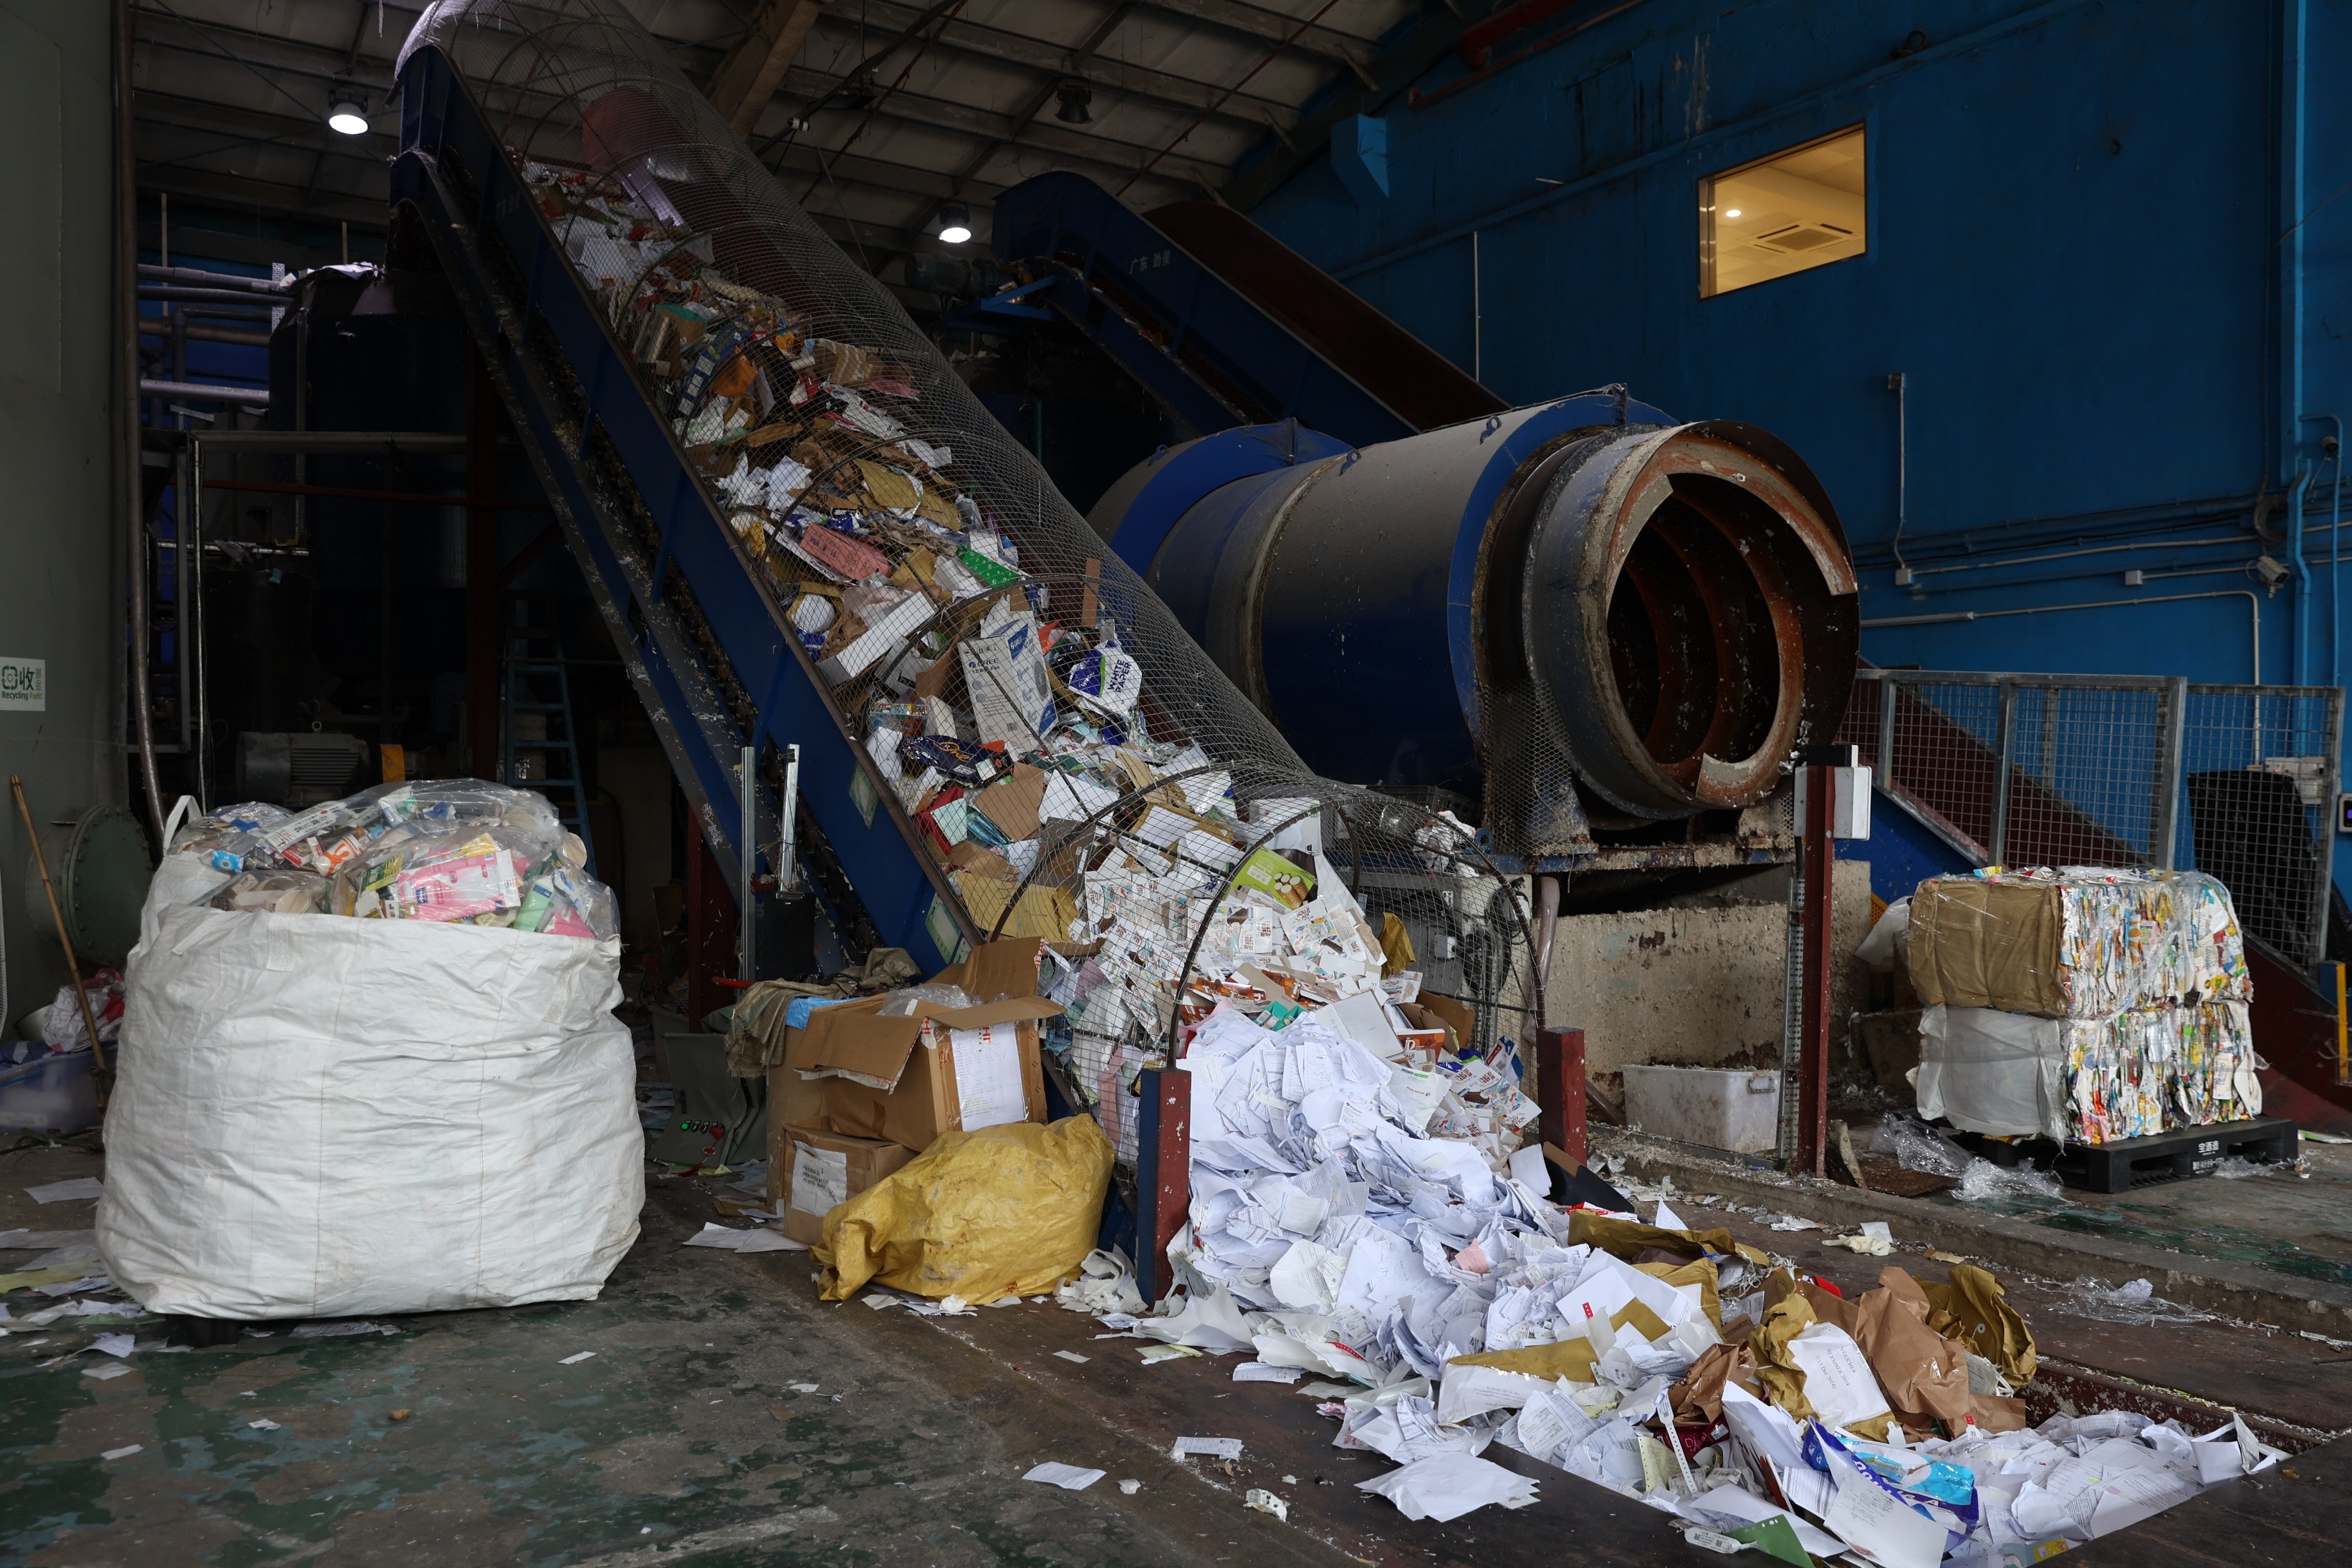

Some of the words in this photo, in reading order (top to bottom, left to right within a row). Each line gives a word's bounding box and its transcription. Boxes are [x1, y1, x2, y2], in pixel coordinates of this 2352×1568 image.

[1107, 659, 1125, 691] WHITE
[1115, 663, 1132, 693] PAPER
[2, 691, 29, 701] Recycling
[1297, 907, 1310, 918] STICK
[1510, 1115, 1520, 1125] JOY
[1840, 1347, 1857, 1374] VOUCHER
[1857, 1352, 1866, 1365] Poon
[1827, 1348, 1843, 1375] DECEMBER
[1841, 1375, 1851, 1386] 2014
[1826, 1375, 1836, 1389] 2014)
[1924, 1498, 1940, 1507] A
